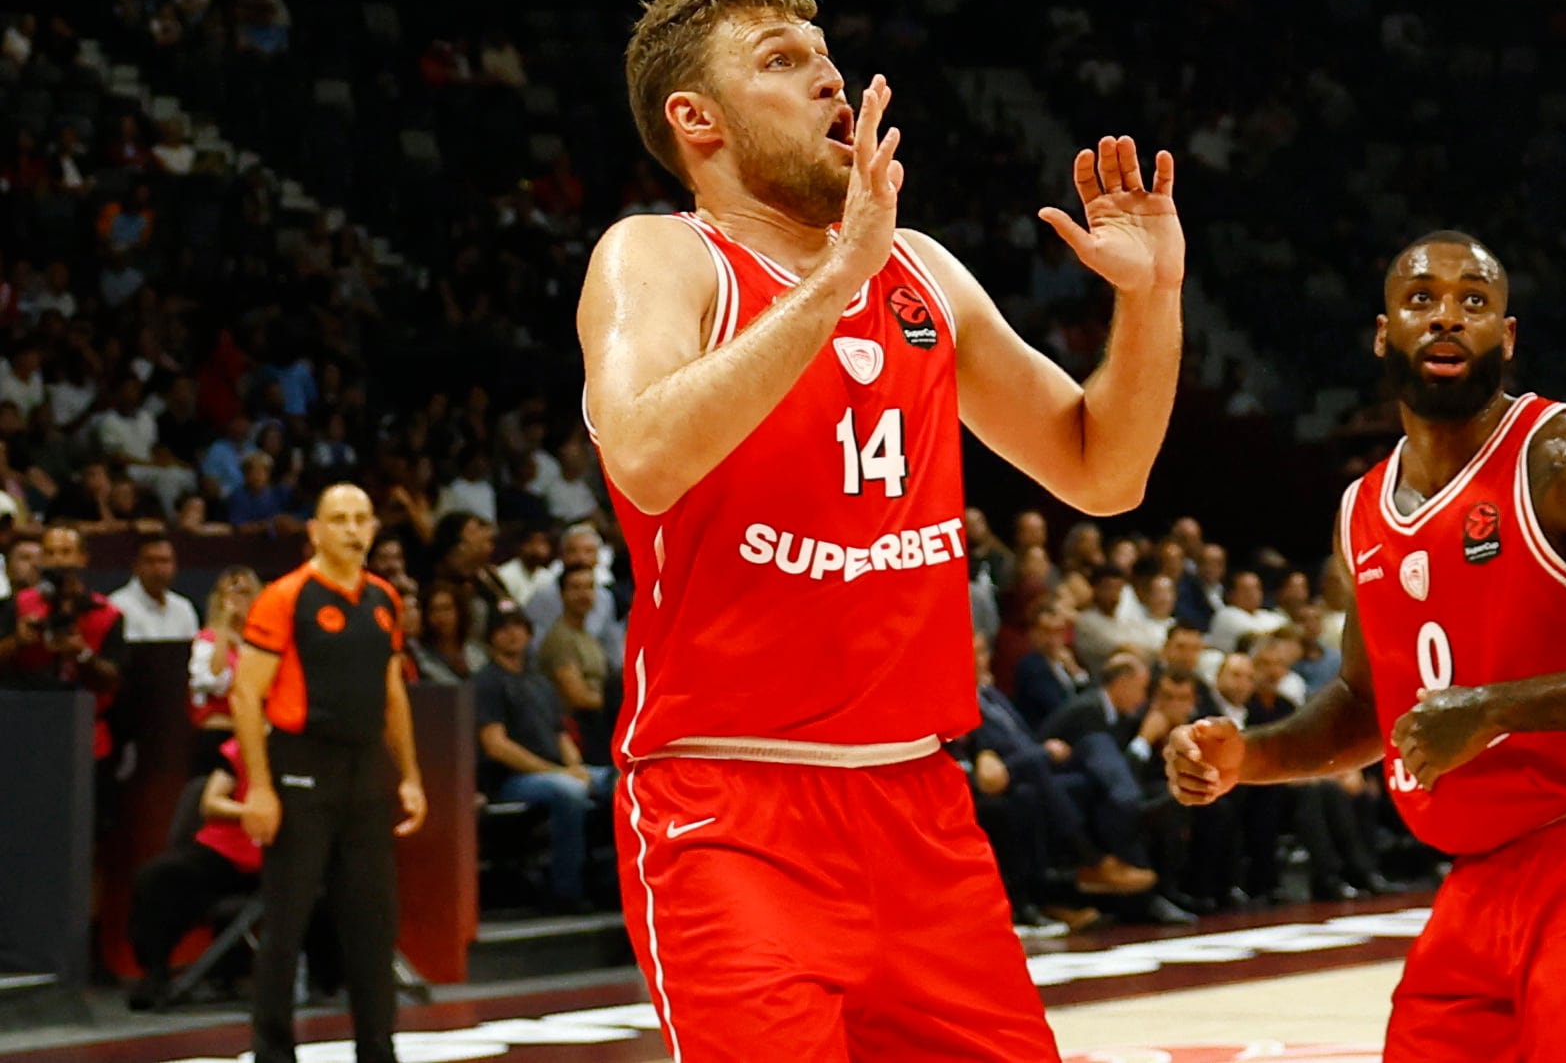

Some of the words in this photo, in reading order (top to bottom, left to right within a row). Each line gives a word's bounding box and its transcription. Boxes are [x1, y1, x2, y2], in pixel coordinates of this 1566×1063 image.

[836, 407, 908, 499] 14
[739, 517, 965, 582] SUPERBET
[1417, 621, 1453, 691] 0
